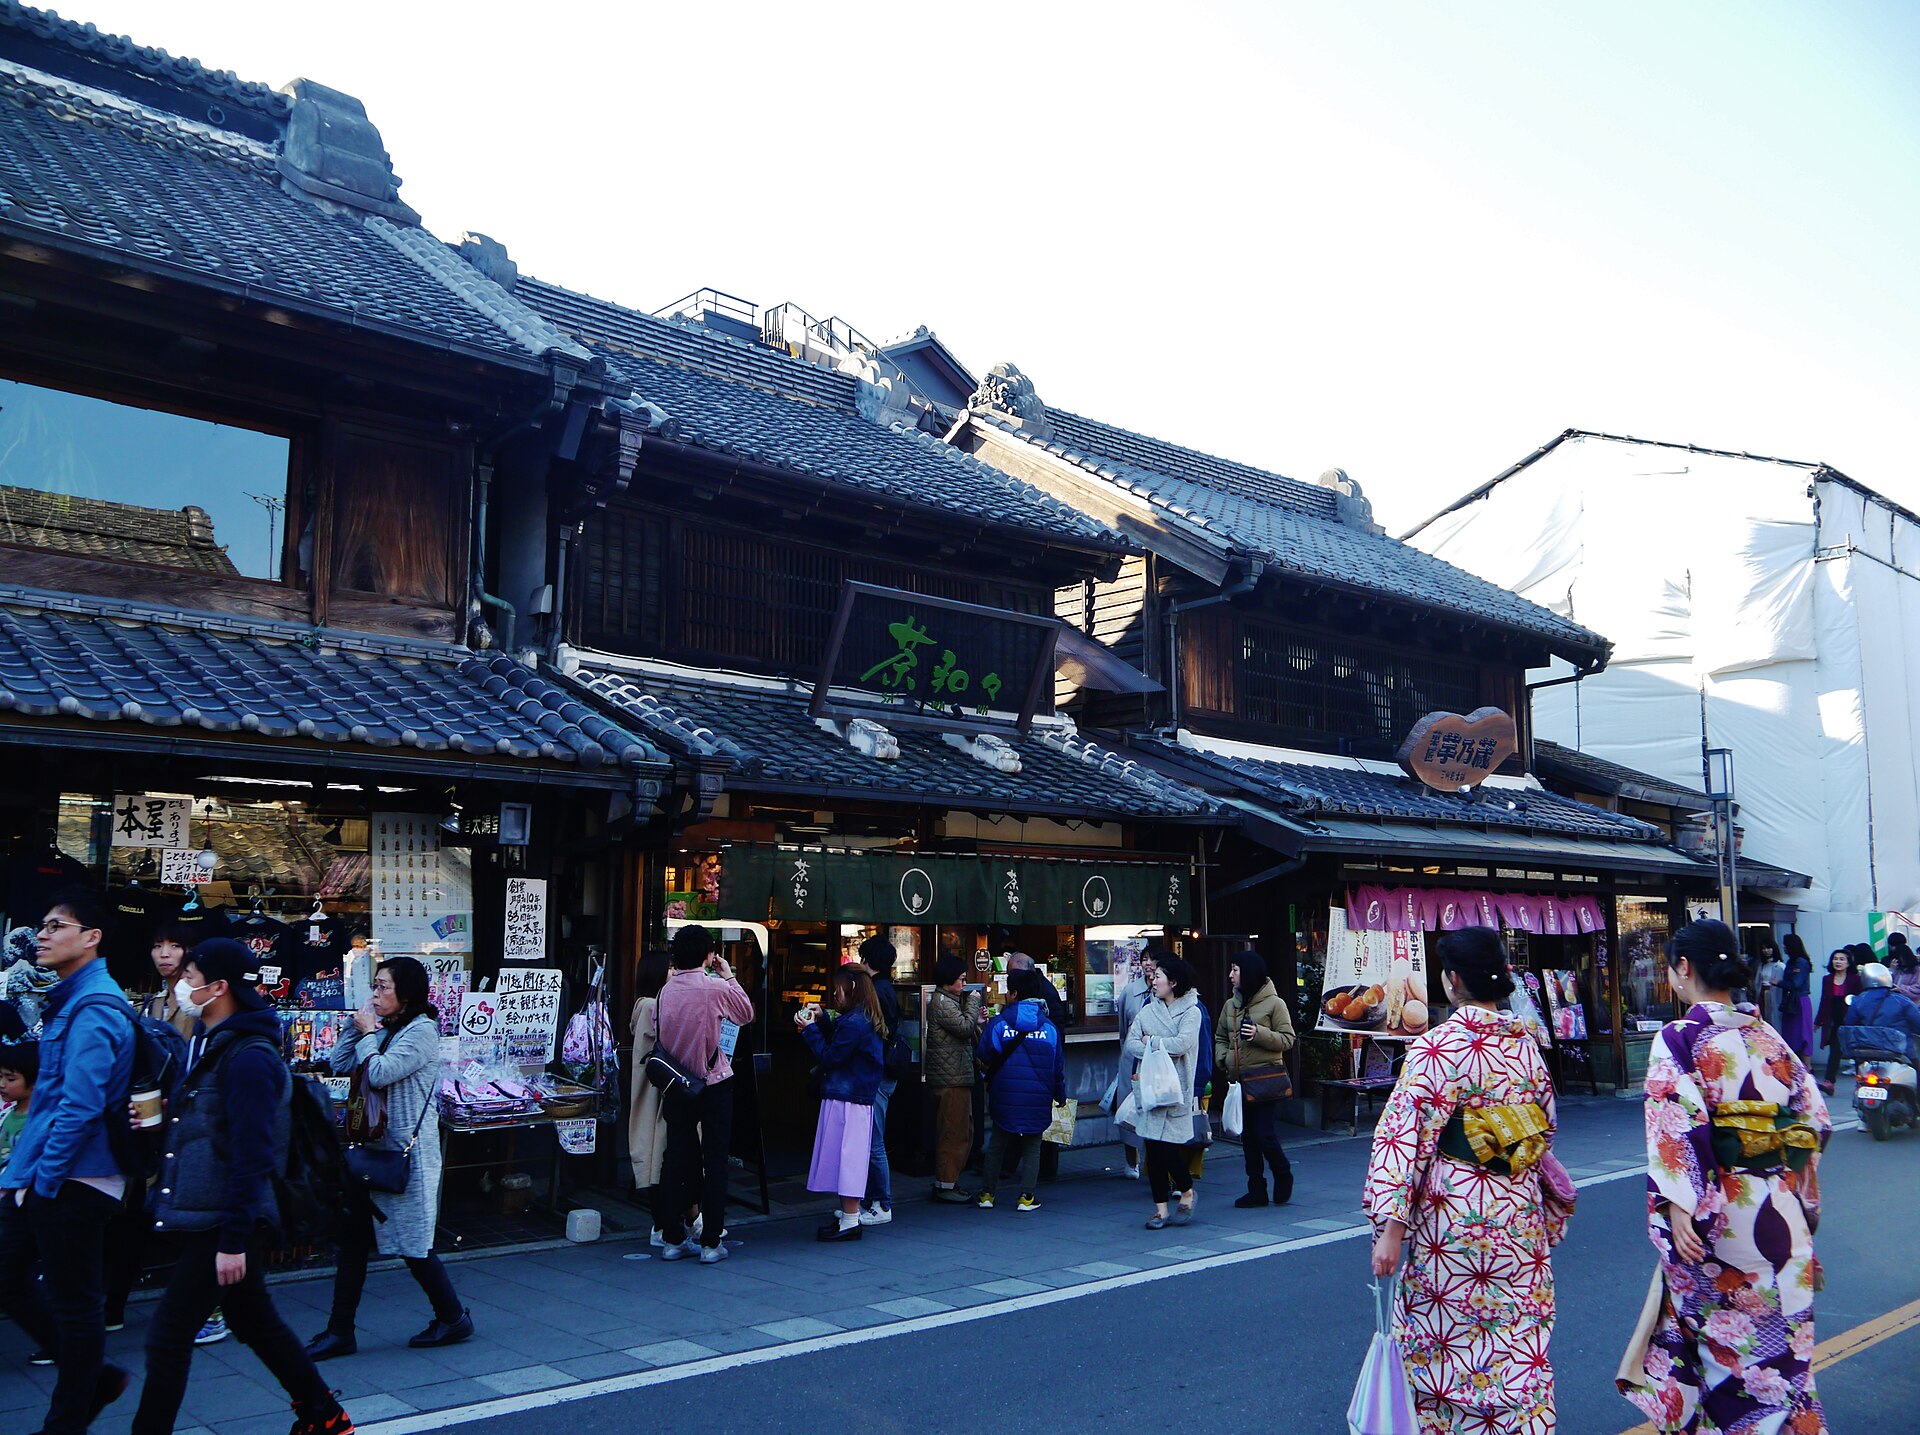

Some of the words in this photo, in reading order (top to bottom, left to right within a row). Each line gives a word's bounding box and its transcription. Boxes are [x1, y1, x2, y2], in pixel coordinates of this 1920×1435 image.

[860, 615, 1002, 701] 茶和々
[881, 692, 894, 703] SA
[115, 797, 167, 839] 本屋
[790, 859, 811, 908] 茶和々
[1003, 869, 1019, 914] 茶和々
[1169, 875, 1180, 915] 茶和々
[467, 1011, 487, 1028] 和
[1003, 1029, 1047, 1040] ATETA
